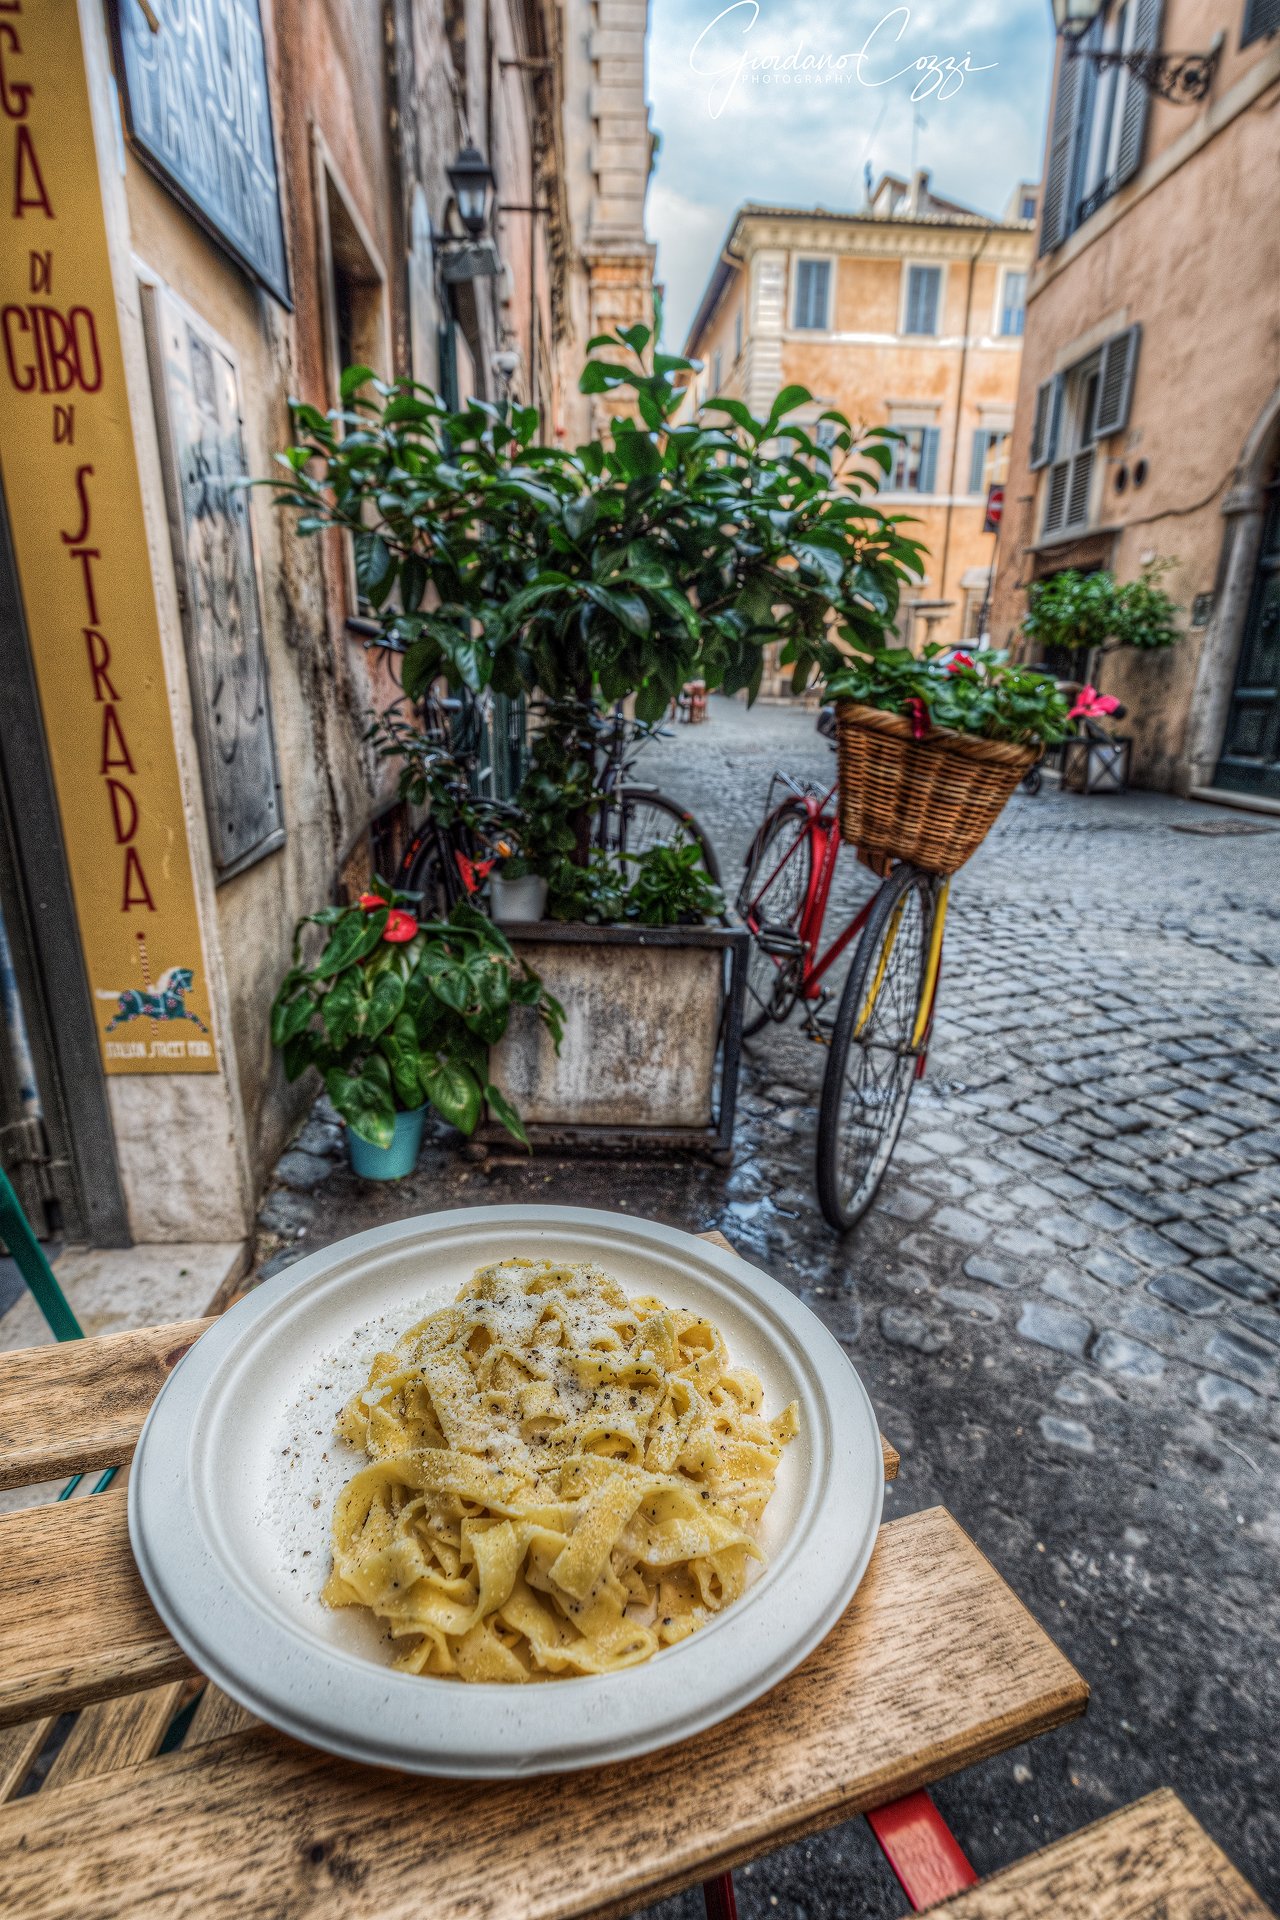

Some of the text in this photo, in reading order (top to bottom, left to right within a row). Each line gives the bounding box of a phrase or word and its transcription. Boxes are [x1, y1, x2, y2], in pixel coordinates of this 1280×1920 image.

[0, 0, 55, 219] GA
[29, 250, 52, 294] DI
[1, 303, 102, 394] CIBO
[53, 404, 74, 445] DI
[60, 464, 156, 913] STRADA
